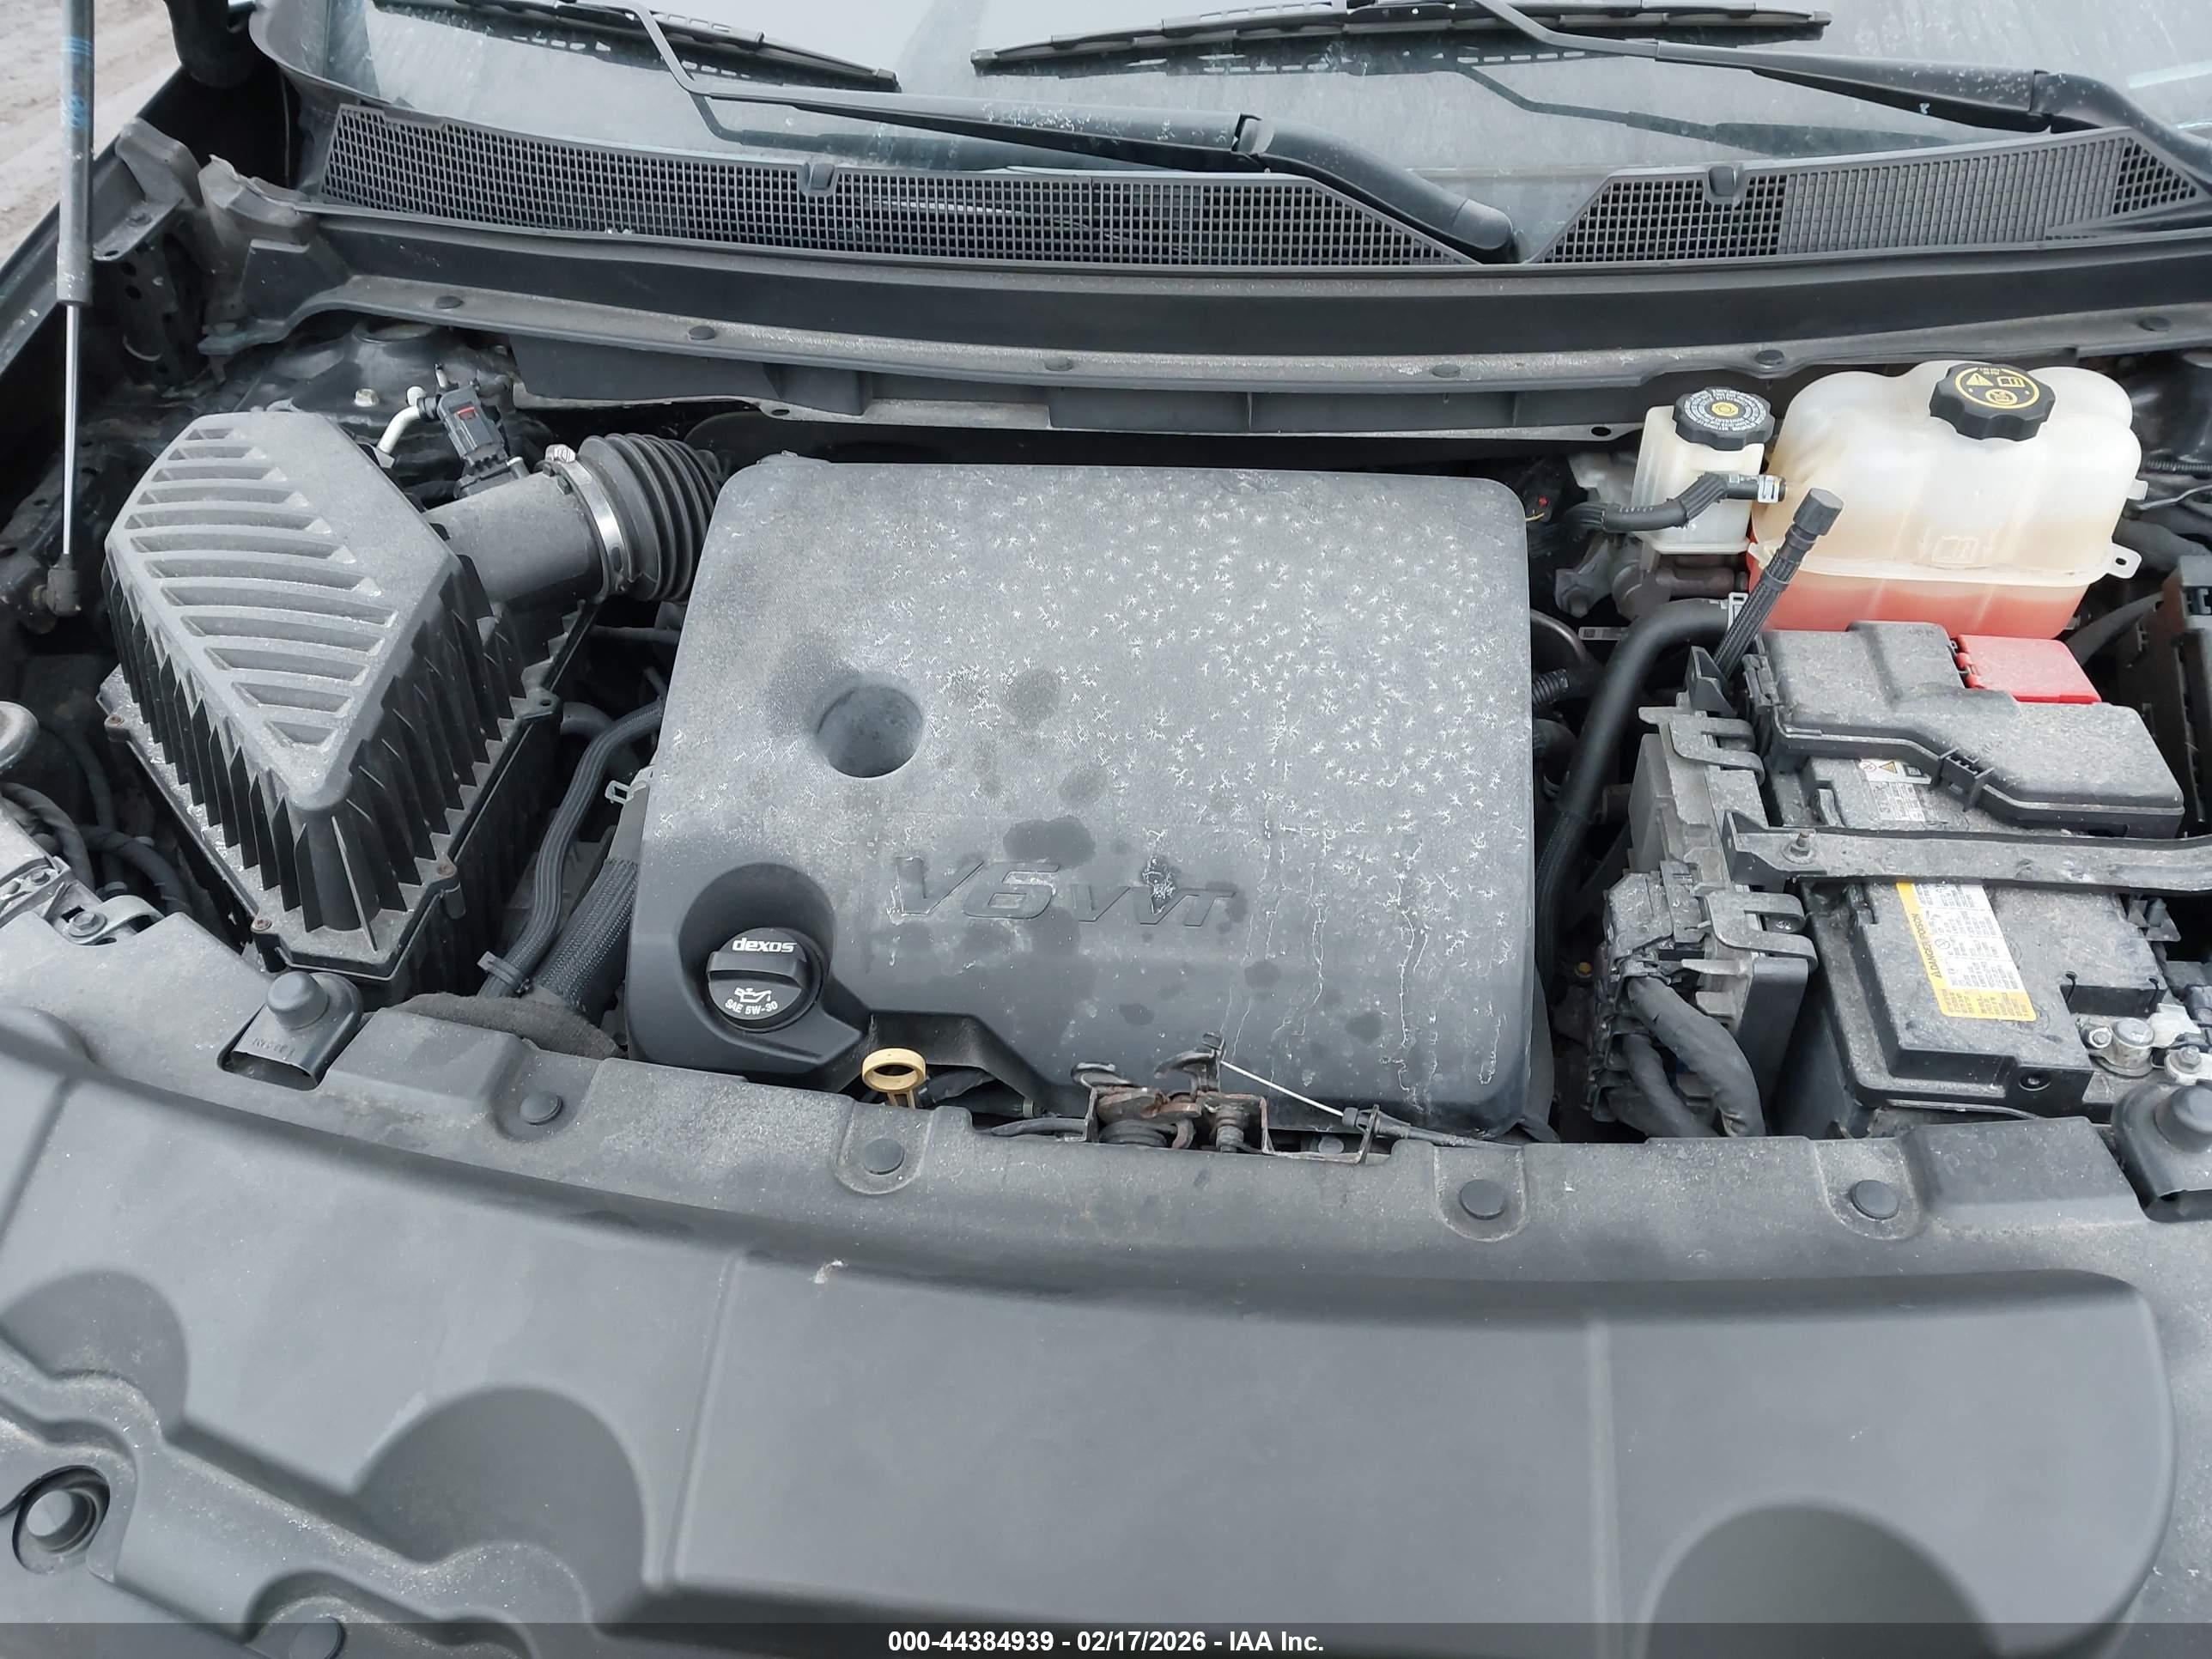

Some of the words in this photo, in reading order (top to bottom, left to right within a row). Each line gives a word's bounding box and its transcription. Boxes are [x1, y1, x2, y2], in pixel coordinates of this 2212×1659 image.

[895, 855, 1061, 920] V6
[732, 937, 798, 953] dexos
[725, 998, 744, 1013] SAE
[744, 1000, 779, 1016] 5W-30
